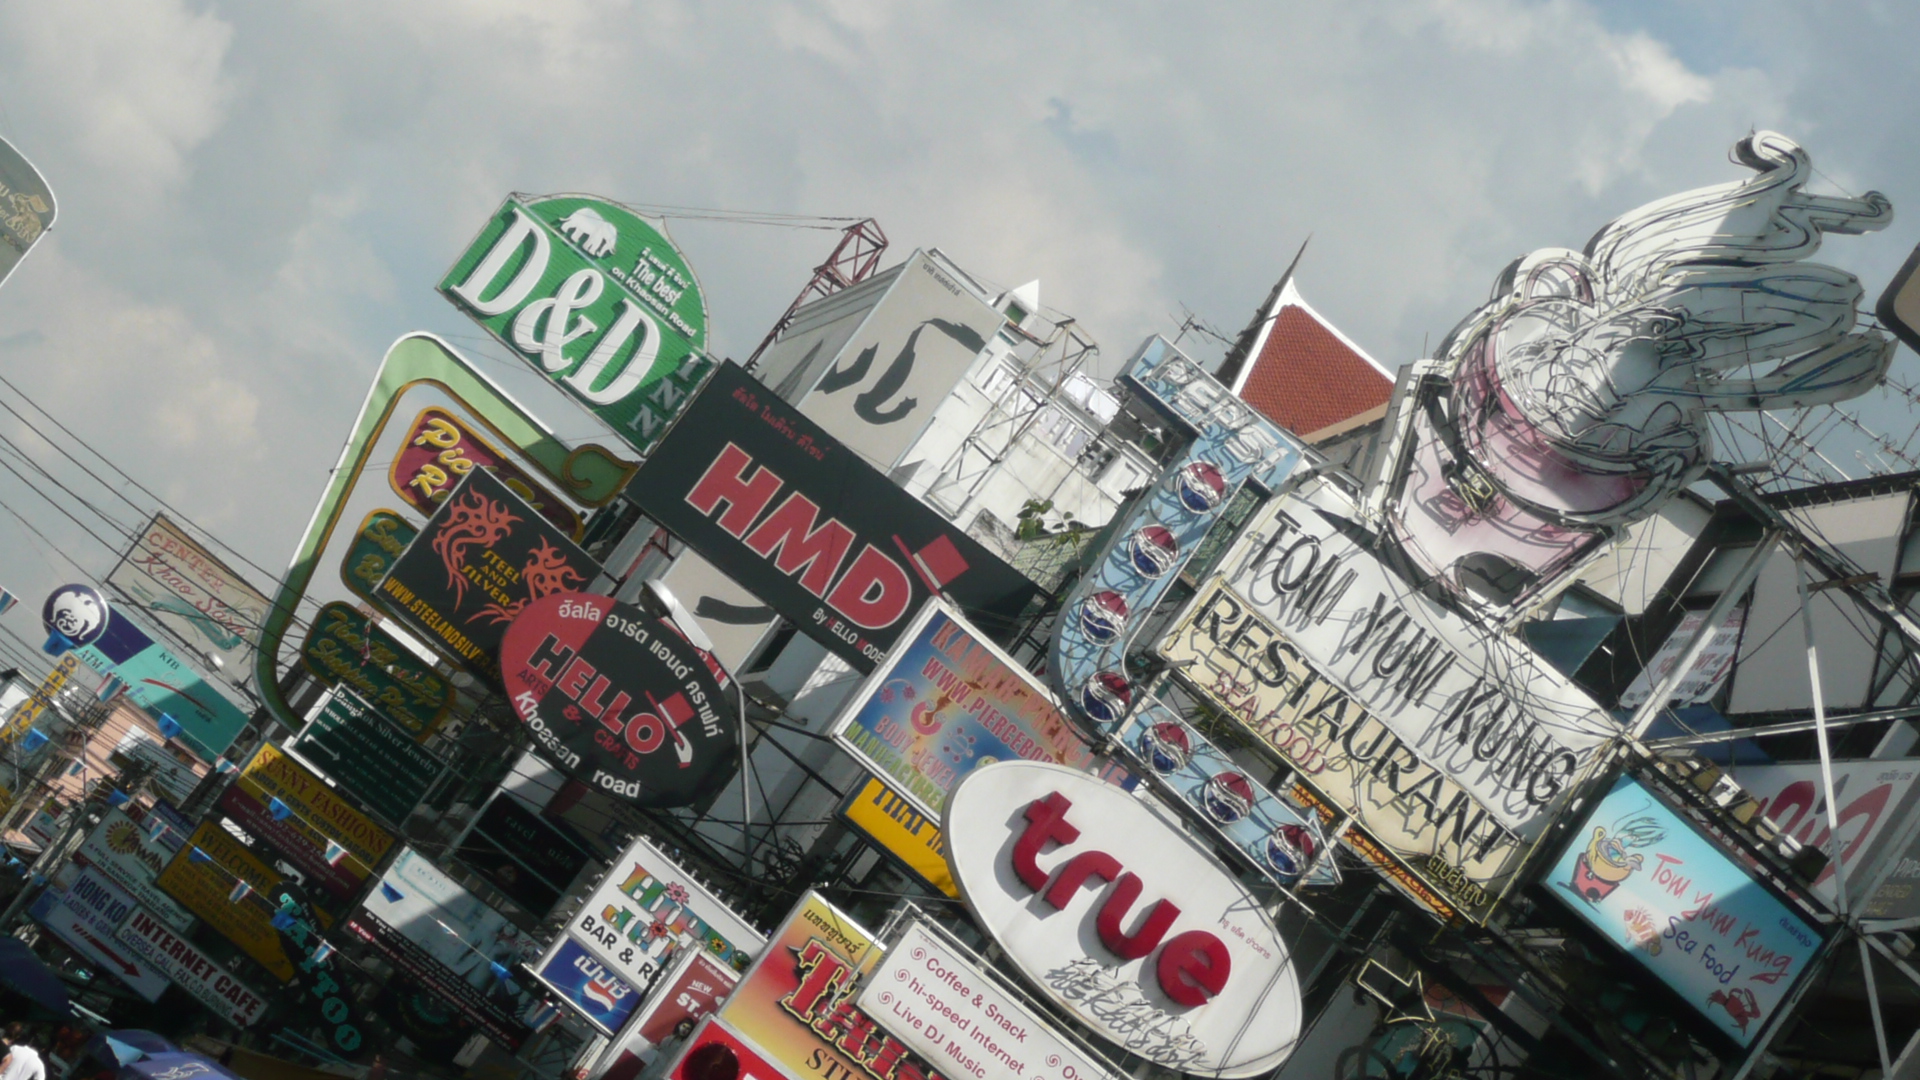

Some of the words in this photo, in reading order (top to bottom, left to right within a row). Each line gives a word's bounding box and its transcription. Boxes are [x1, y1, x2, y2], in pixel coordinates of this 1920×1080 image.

[451, 207, 660, 405] D&D
[611, 266, 625, 281] on
[625, 275, 670, 316] Khaosan
[669, 311, 697, 338] Road
[629, 257, 659, 286] The
[650, 274, 684, 306] best
[684, 441, 911, 629] HMD
[132, 547, 202, 602] Khao
[148, 531, 226, 590] CENTER
[480, 564, 508, 588] AND
[481, 550, 520, 586] STEEL
[1249, 510, 1358, 626] TOM
[461, 565, 511, 607] SILVER
[812, 608, 827, 627] By
[826, 615, 858, 645] HELLO
[79, 650, 103, 670] ATM
[158, 652, 181, 671] KTB
[517, 669, 549, 696] ARTS
[527, 632, 665, 754] HELLO
[330, 689, 378, 729] Bangkok
[373, 721, 405, 748] Silver
[399, 741, 440, 777] Jewelry
[594, 729, 640, 771] CRAFTS
[873, 715, 915, 757] BODY
[1193, 589, 1520, 862] RESTAURANT
[255, 748, 311, 796] SUNNY
[309, 789, 388, 855] FASHIONS
[591, 769, 641, 798] road
[310, 812, 342, 839] CUSTOM
[93, 847, 111, 862] FULL
[104, 866, 138, 893] BANGKOK
[197, 831, 273, 892] WELCOME
[71, 873, 112, 912] HONG
[1012, 791, 1232, 1007] true
[578, 914, 619, 950] BAR
[616, 945, 637, 966] &
[1663, 915, 1697, 955] Sea
[128, 910, 219, 985] INTERNET
[210, 972, 262, 1017] CAFE
[692, 980, 713, 994] NEW
[926, 957, 971, 997] Coffee
[971, 994, 984, 1008] &
[984, 1003, 1028, 1044] Snack
[893, 1001, 922, 1030] Live
[924, 1024, 945, 1045] DJ
[945, 1041, 987, 1079] Music
[908, 978, 971, 1031] hi-speed
[969, 1025, 1025, 1076] Internet
